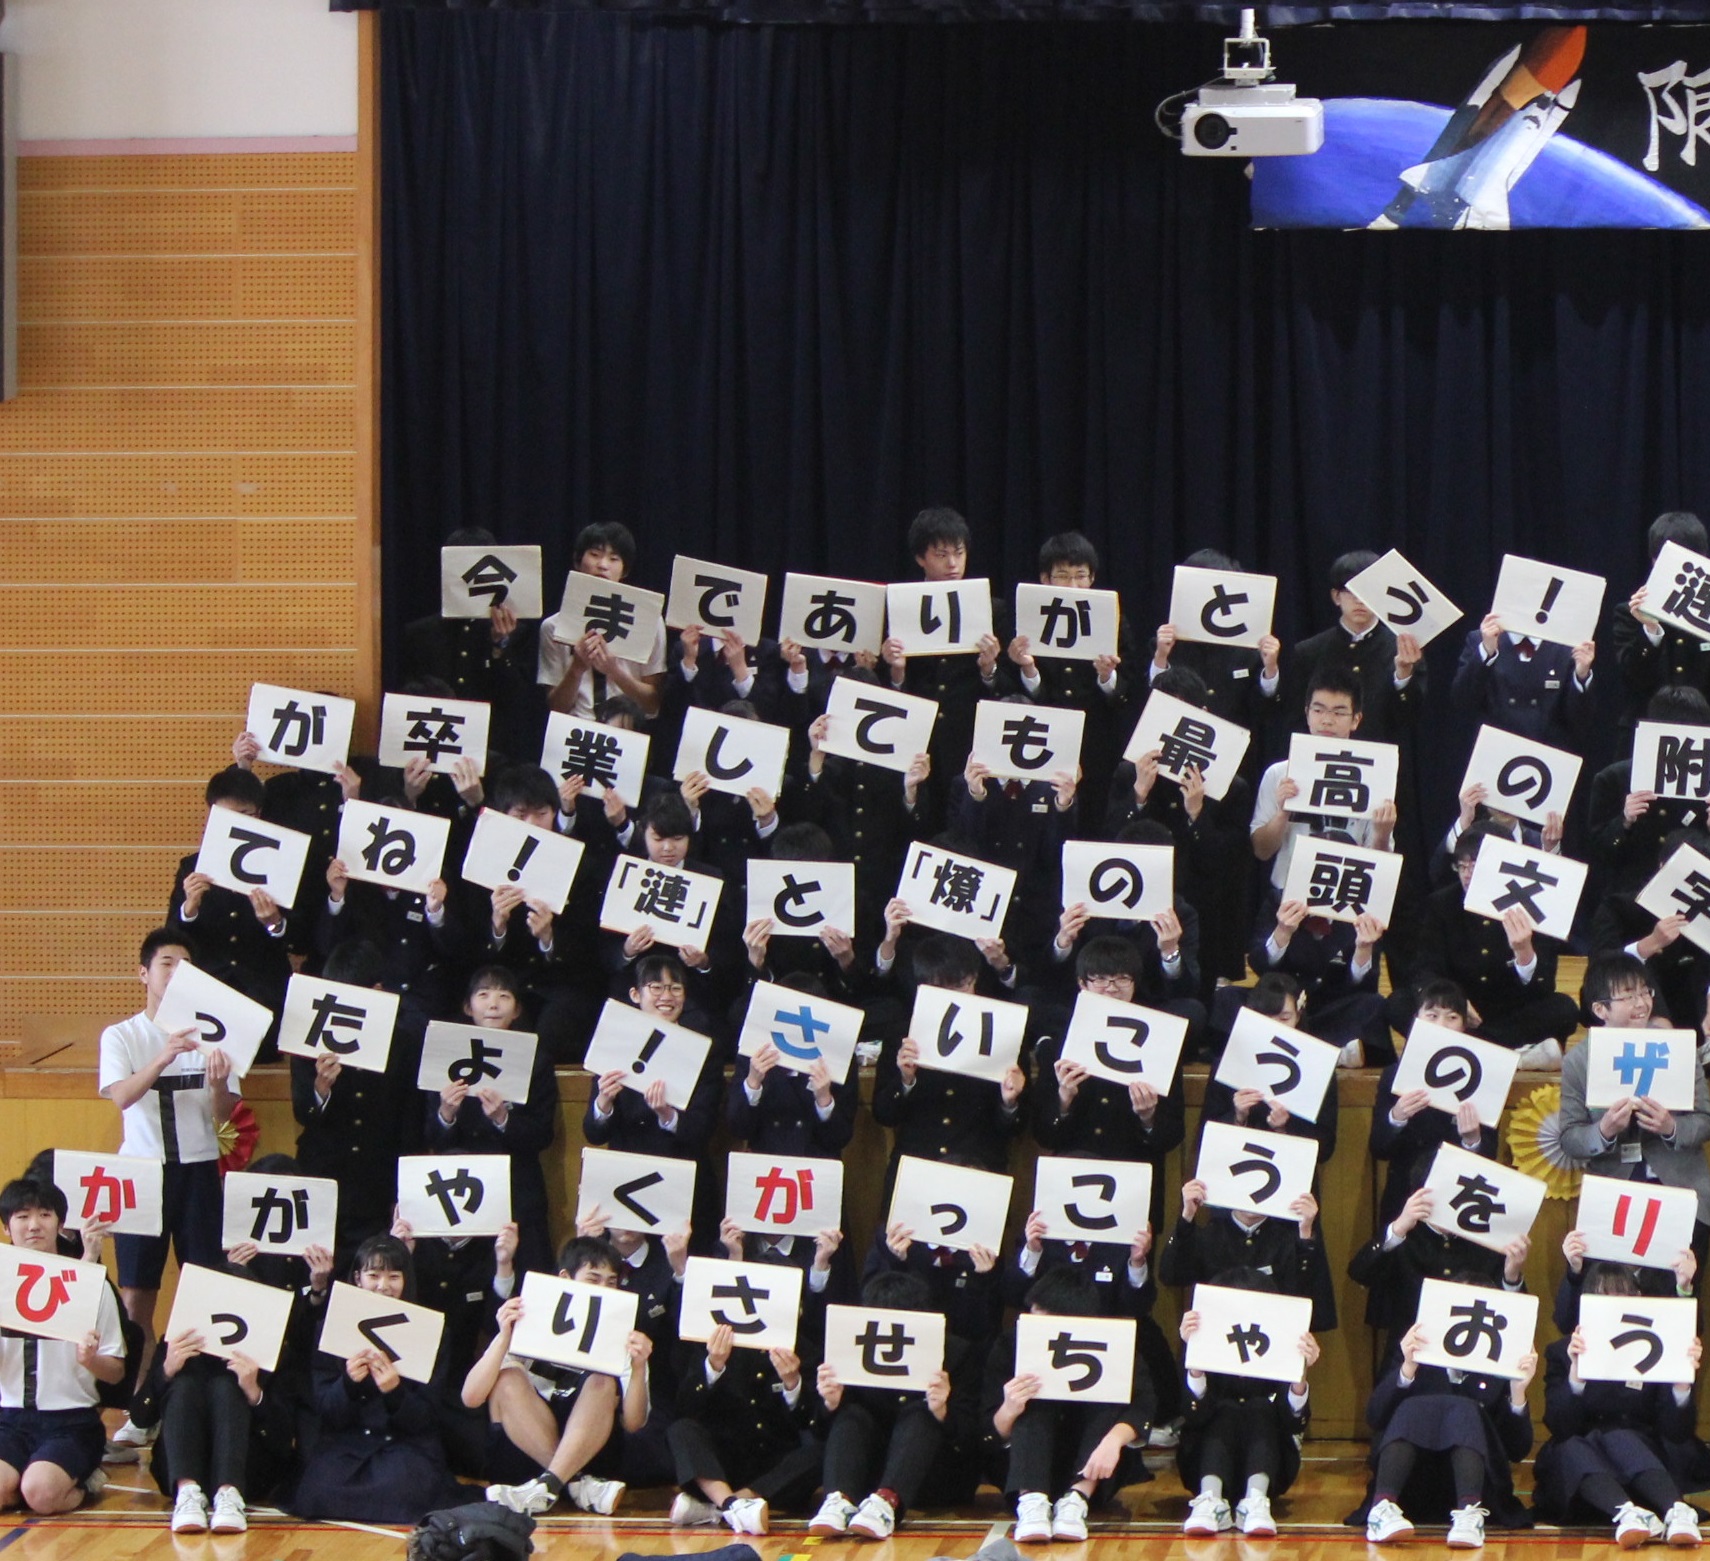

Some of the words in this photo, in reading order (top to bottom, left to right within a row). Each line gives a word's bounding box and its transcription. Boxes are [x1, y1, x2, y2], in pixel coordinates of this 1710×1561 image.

[462, 554, 518, 607] 今
[695, 575, 742, 627] で
[1387, 581, 1429, 625] う
[1536, 578, 1563, 623] ！
[584, 593, 634, 643] ま
[804, 590, 856, 643] あ
[921, 591, 960, 643] り
[1040, 598, 1090, 648] が
[1201, 585, 1248, 637] と
[269, 701, 326, 756] が
[404, 708, 464, 763] 卒
[855, 698, 907, 754] て
[1002, 716, 1053, 769] も
[1152, 717, 1216, 779] 最
[561, 729, 621, 789] 業
[706, 727, 752, 780] し
[1310, 751, 1373, 812] 高
[1497, 756, 1551, 809] の
[230, 827, 279, 884] て
[362, 817, 415, 875] ね
[508, 836, 538, 881] ！
[619, 862, 706, 928] 「漣」
[774, 875, 823, 927] と
[913, 851, 999, 921] 「燎」
[1090, 859, 1142, 909] の
[1307, 853, 1374, 915] 頭
[1491, 860, 1559, 924] 文
[196, 1012, 225, 1041] っ
[305, 994, 366, 1054] た
[774, 1008, 829, 1058] さ
[938, 1003, 992, 1056] い
[1095, 1017, 1148, 1072] こ
[448, 1039, 502, 1086] よ
[632, 1030, 664, 1073] ！
[1256, 1037, 1299, 1095] う
[1425, 1047, 1481, 1101] の
[1616, 1045, 1666, 1095] ザ
[81, 1167, 134, 1222] か
[426, 1169, 483, 1215] や
[614, 1172, 662, 1226] く
[756, 1168, 811, 1223] が
[1230, 1143, 1280, 1203] う
[251, 1188, 308, 1243] が
[931, 1204, 966, 1235] っ
[1064, 1175, 1117, 1229] こ
[1449, 1176, 1505, 1232] を
[1614, 1197, 1658, 1255] リ
[17, 1264, 75, 1322] び
[711, 1277, 768, 1333] さ
[212, 1314, 247, 1345] っ
[358, 1314, 408, 1362] く
[553, 1293, 600, 1353] り
[856, 1322, 914, 1375] せ
[1227, 1325, 1268, 1362] ゃ
[1444, 1301, 1506, 1361] お
[1611, 1315, 1662, 1373] う
[1049, 1333, 1106, 1391] ち
